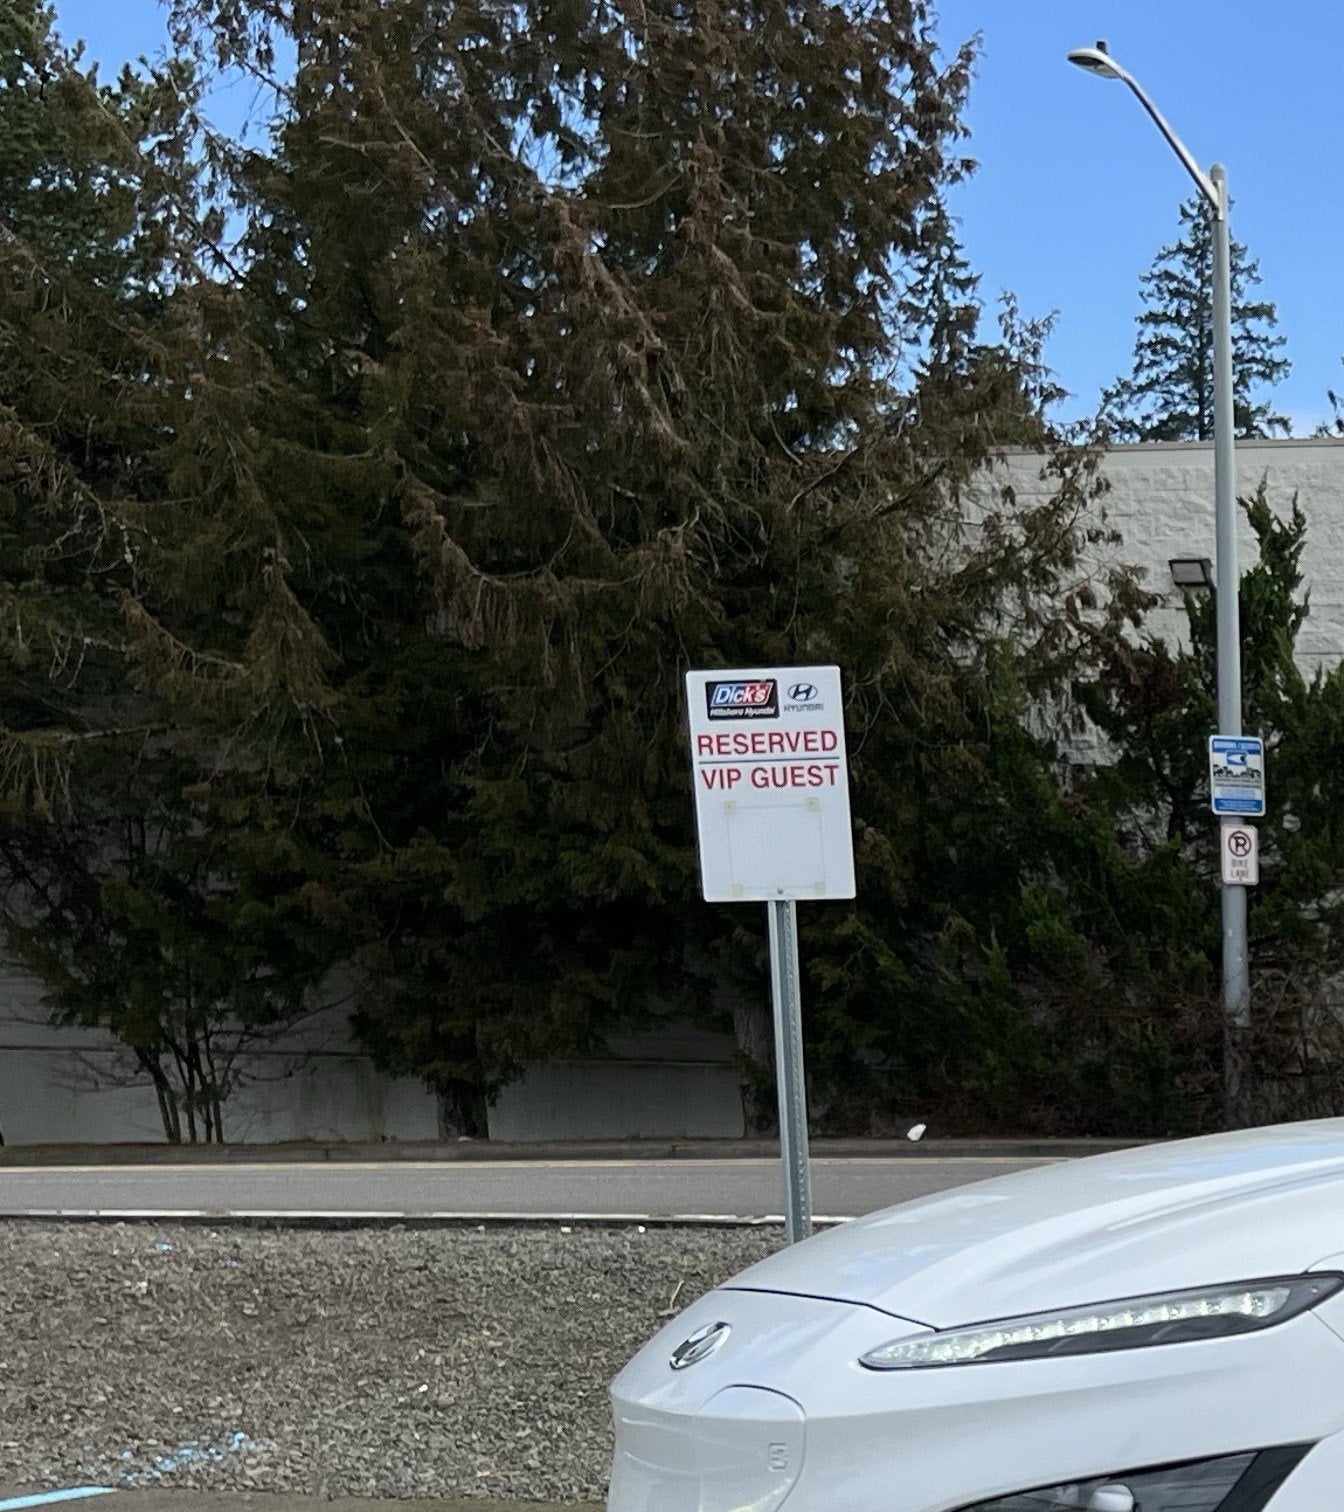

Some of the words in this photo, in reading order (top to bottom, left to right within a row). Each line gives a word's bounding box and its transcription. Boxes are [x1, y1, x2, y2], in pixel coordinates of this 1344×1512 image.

[697, 730, 838, 756] RESERVED
[701, 767, 741, 790] VIP
[751, 764, 839, 788] GUEST
